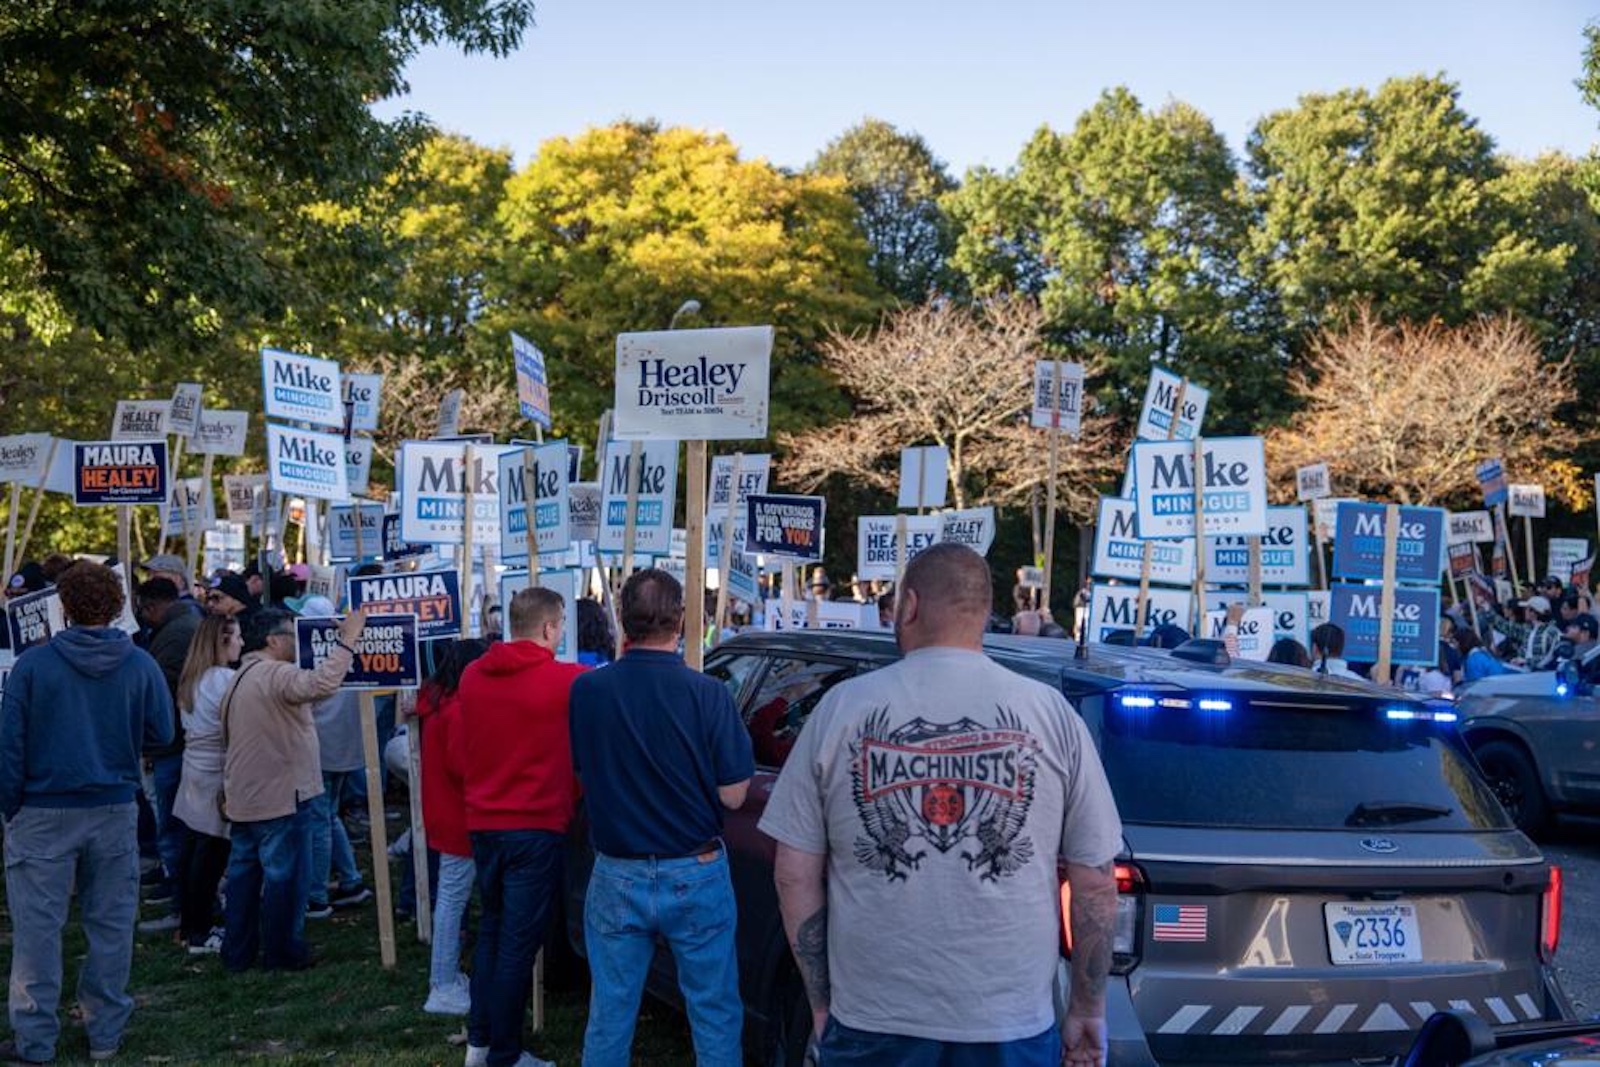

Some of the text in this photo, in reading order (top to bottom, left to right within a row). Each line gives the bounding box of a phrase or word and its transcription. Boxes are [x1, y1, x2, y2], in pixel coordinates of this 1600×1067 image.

[274, 359, 332, 393] Mike
[638, 355, 747, 395] Healey
[638, 388, 716, 406] Driscoll
[84, 445, 156, 467] MAURA
[279, 434, 336, 467] Mike
[83, 468, 156, 488] HEALEY
[281, 463, 336, 485] MINOGUE
[508, 460, 559, 505] Mke
[610, 452, 665, 495] Mke
[715, 473, 763, 491] HELEY
[340, 512, 376, 529] Mke
[756, 503, 815, 519] A GOVERNOR
[756, 515, 815, 532] WHO WORKS
[943, 520, 983, 536] HEALEY
[1354, 512, 1426, 540] Mke
[756, 527, 812, 546] FOR YOU.
[1218, 551, 1293, 564] MINGUE
[361, 575, 448, 603] MAURA
[1349, 593, 1421, 620] Mke
[311, 629, 324, 643] A
[1212, 617, 1260, 638] Mke
[361, 653, 405, 673] YOU.
[868, 750, 1017, 790] MACHINISTS
[1354, 918, 1405, 948] 2336
